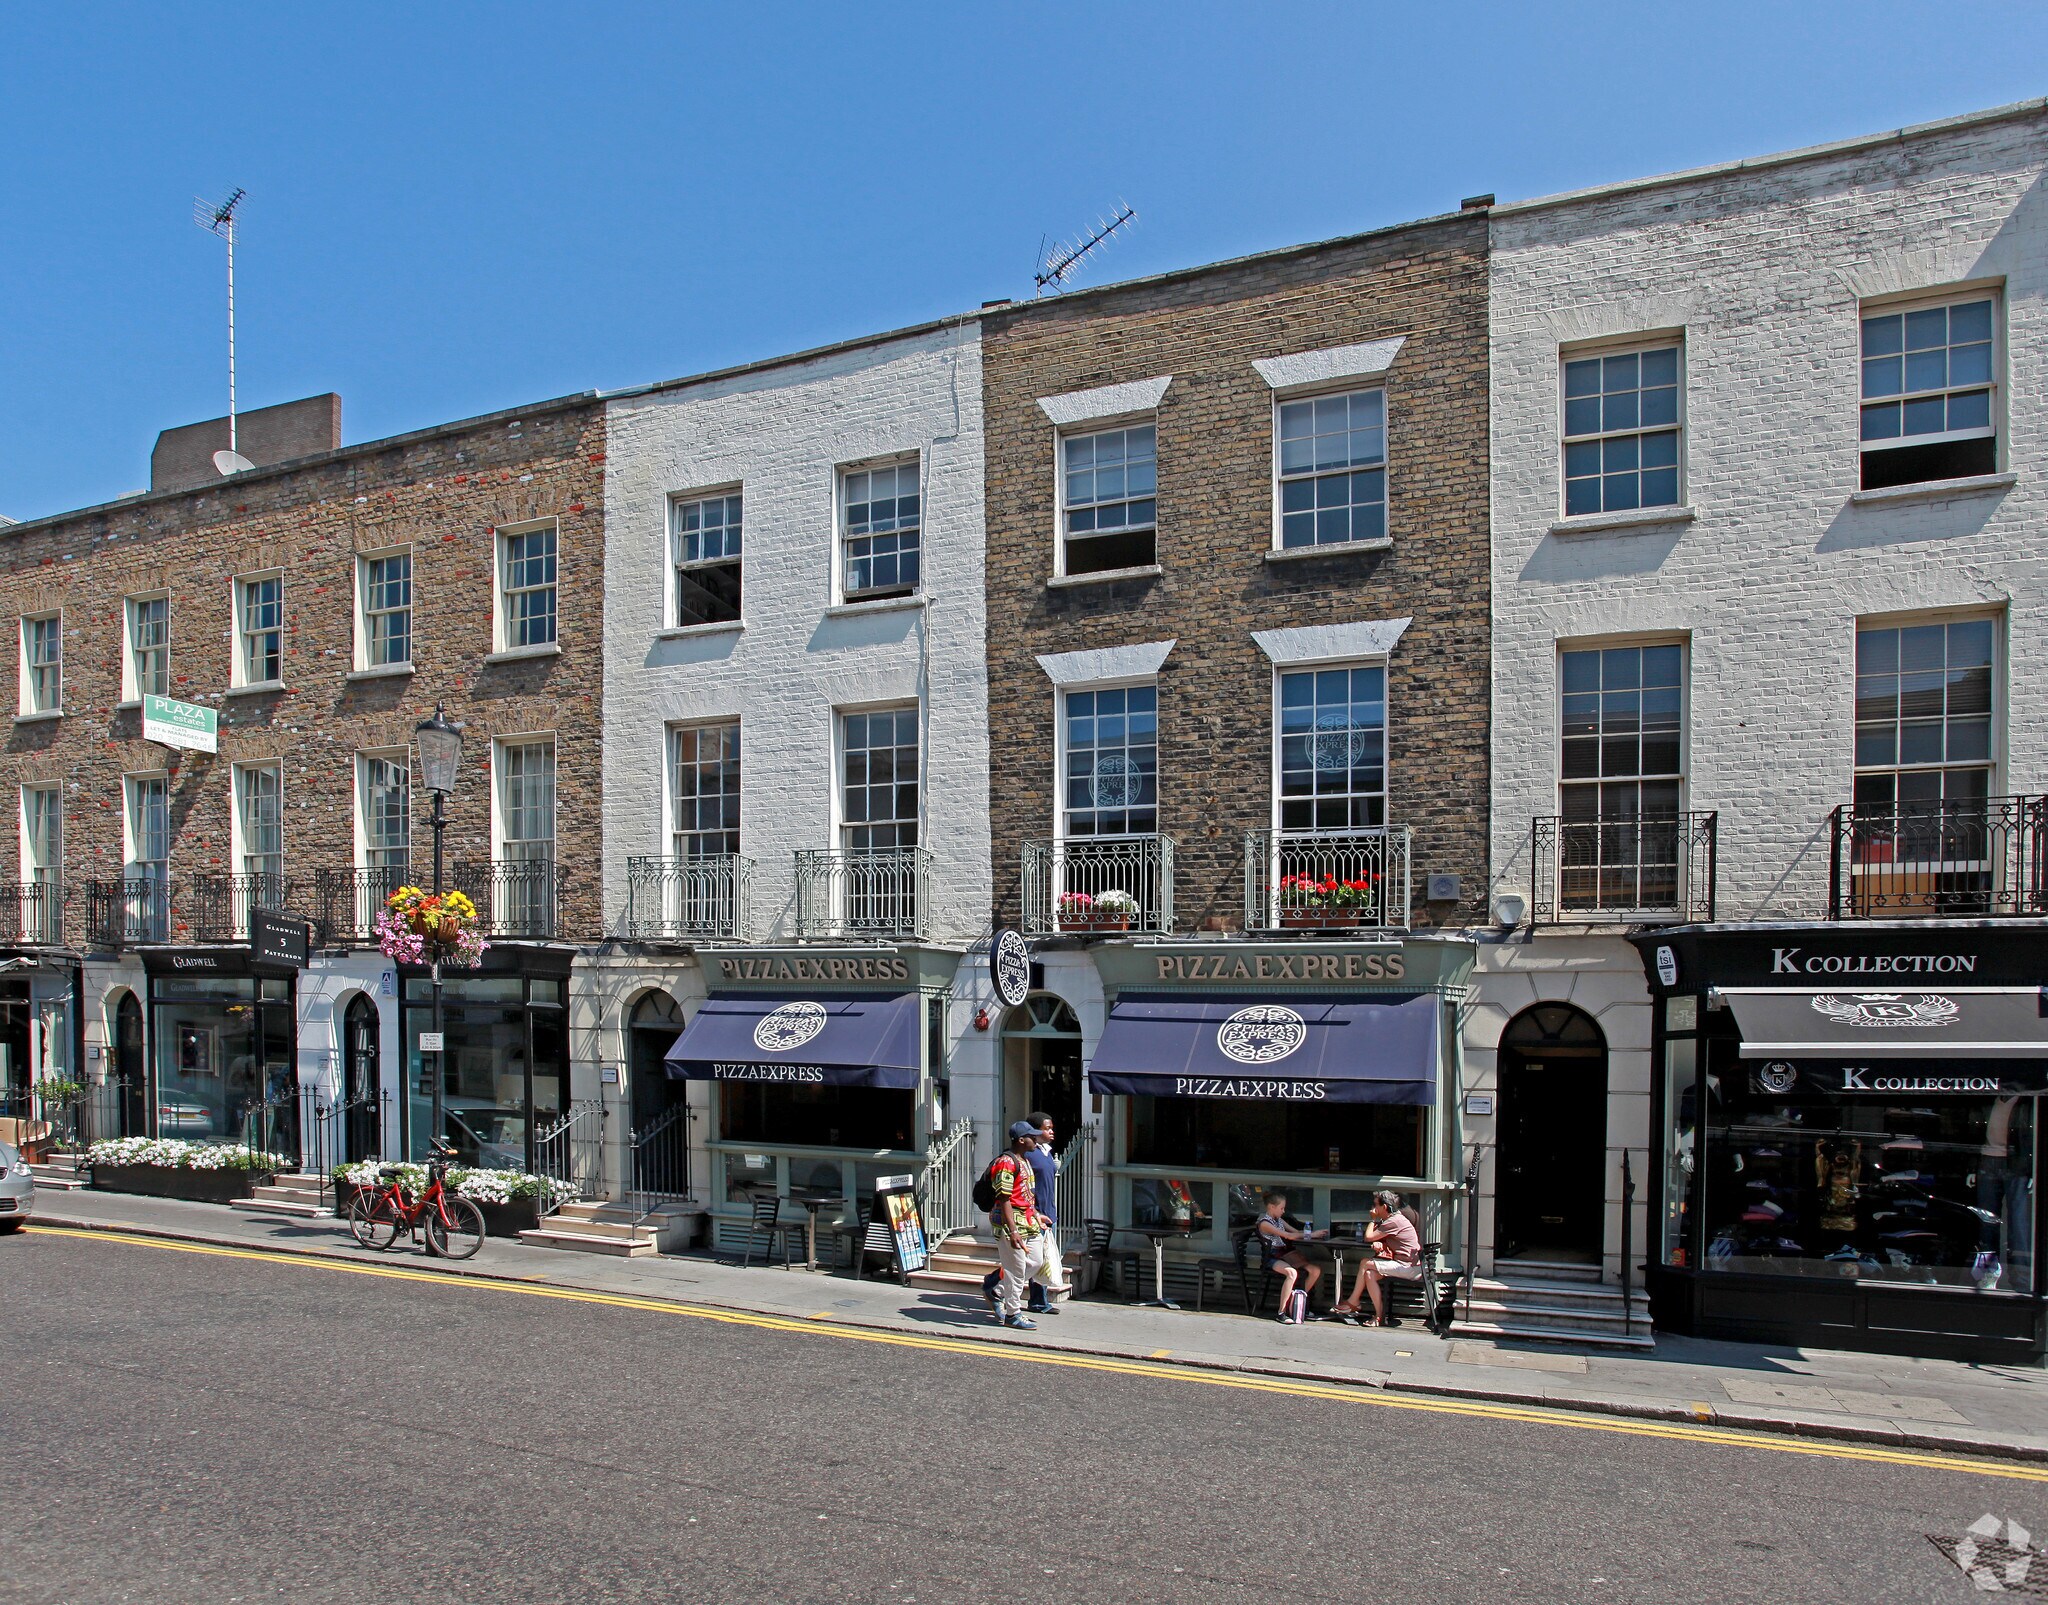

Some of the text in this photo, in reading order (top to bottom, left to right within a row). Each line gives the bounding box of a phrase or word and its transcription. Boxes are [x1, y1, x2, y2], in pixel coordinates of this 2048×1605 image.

[155, 699, 206, 721] PLAZA
[173, 715, 206, 727] estates
[147, 731, 164, 740] 020
[168, 730, 200, 741] MANAGED
[265, 924, 302, 936] GLADWELL
[264, 949, 302, 961] PATTERSON
[1659, 953, 1672, 965] tsi
[1770, 948, 1978, 974] K COLLECTION
[173, 956, 218, 969] GLADWELL
[1004, 955, 1021, 968] PIZZA
[1155, 953, 1406, 980] PIZZAEXPRESS
[718, 958, 910, 981] PIZZAEXPRESS
[1001, 963, 1025, 978] EXPRESS
[1872, 1006, 1909, 1016] K
[763, 1023, 816, 1031] EXPRESS
[776, 1017, 811, 1025] PIZZA
[1241, 1024, 1286, 1032] PIZZA
[1227, 1031, 1296, 1040] EXPRESS
[368, 1045, 375, 1057] 5
[713, 1064, 824, 1083] PIZZAEXPRESS
[1841, 1067, 2000, 1091] K COLLECTION
[1175, 1078, 1326, 1100] PIZZAEXPRESS
